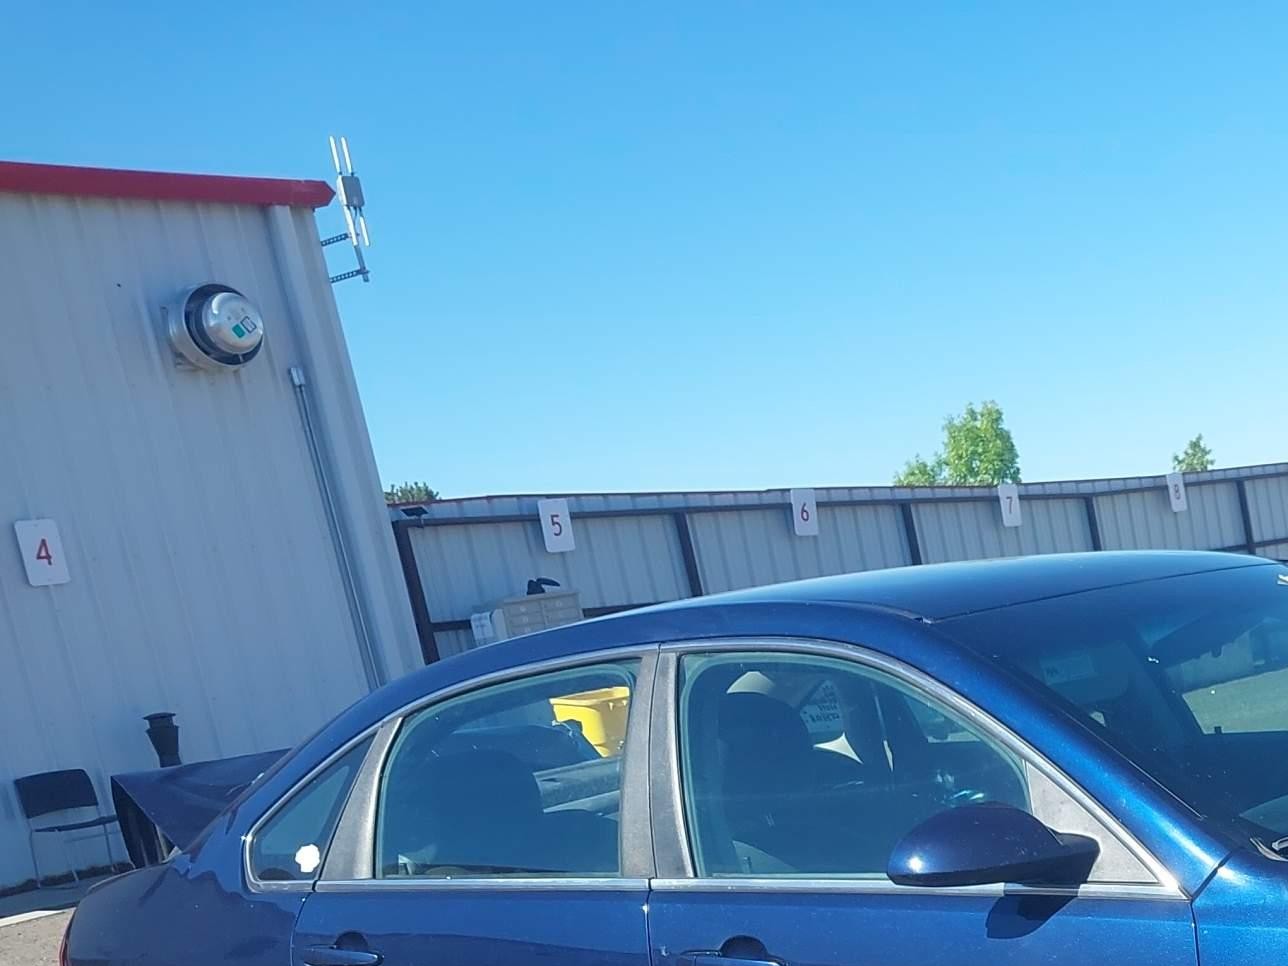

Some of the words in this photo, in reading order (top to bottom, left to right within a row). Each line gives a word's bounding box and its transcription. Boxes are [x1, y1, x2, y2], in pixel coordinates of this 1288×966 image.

[1174, 484, 1181, 500] 8
[800, 502, 810, 521] 6
[1005, 496, 1013, 514] 7
[550, 514, 562, 536] 5
[36, 538, 53, 566] 4
